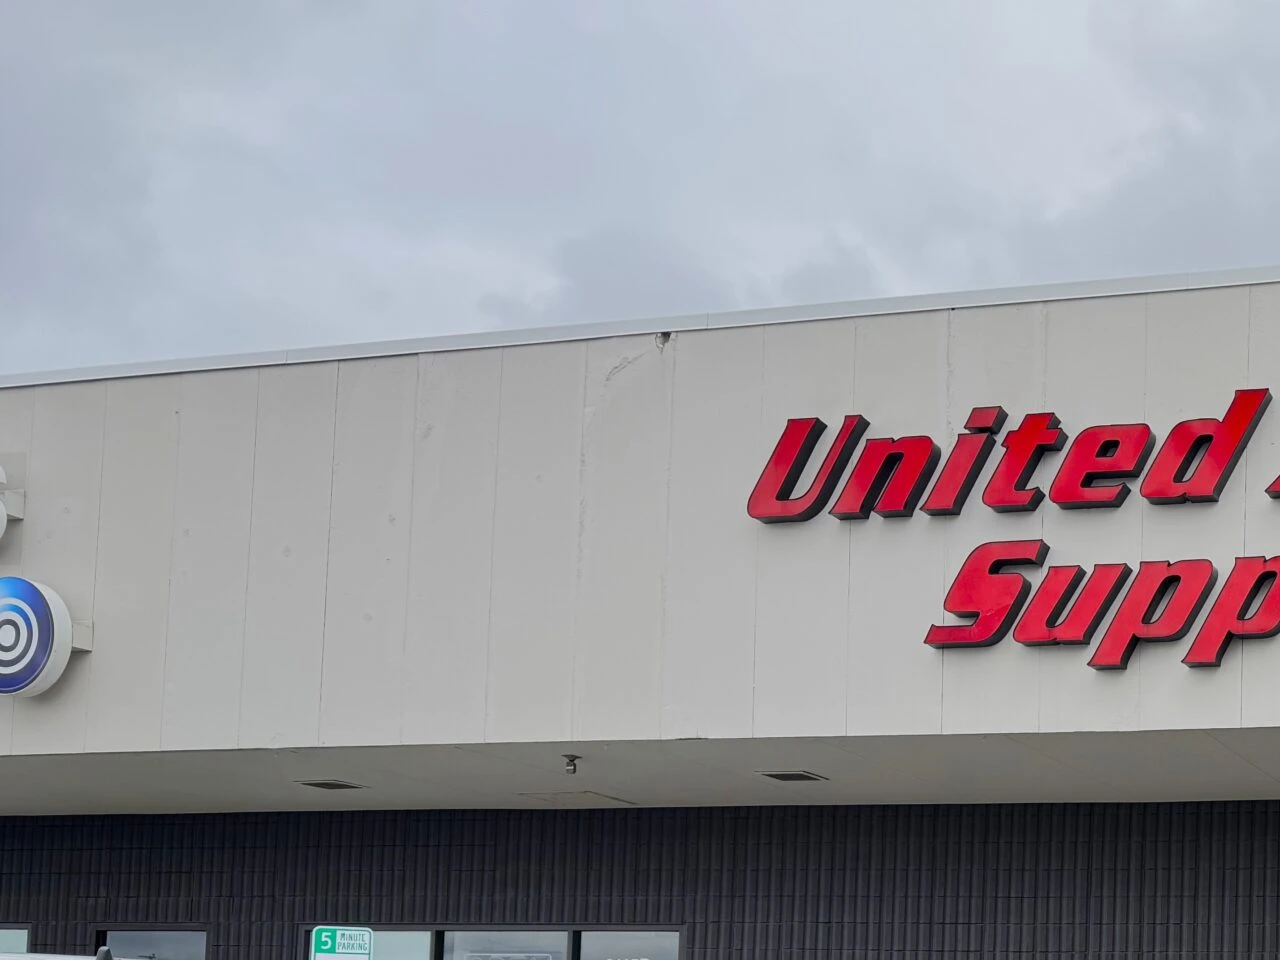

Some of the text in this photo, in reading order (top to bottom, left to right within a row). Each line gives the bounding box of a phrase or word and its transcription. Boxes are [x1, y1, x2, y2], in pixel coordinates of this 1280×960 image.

[747, 387, 1272, 524] United
[321, 931, 332, 950] 5
[340, 932, 367, 942] MINUTE
[337, 942, 368, 951] PARKING
